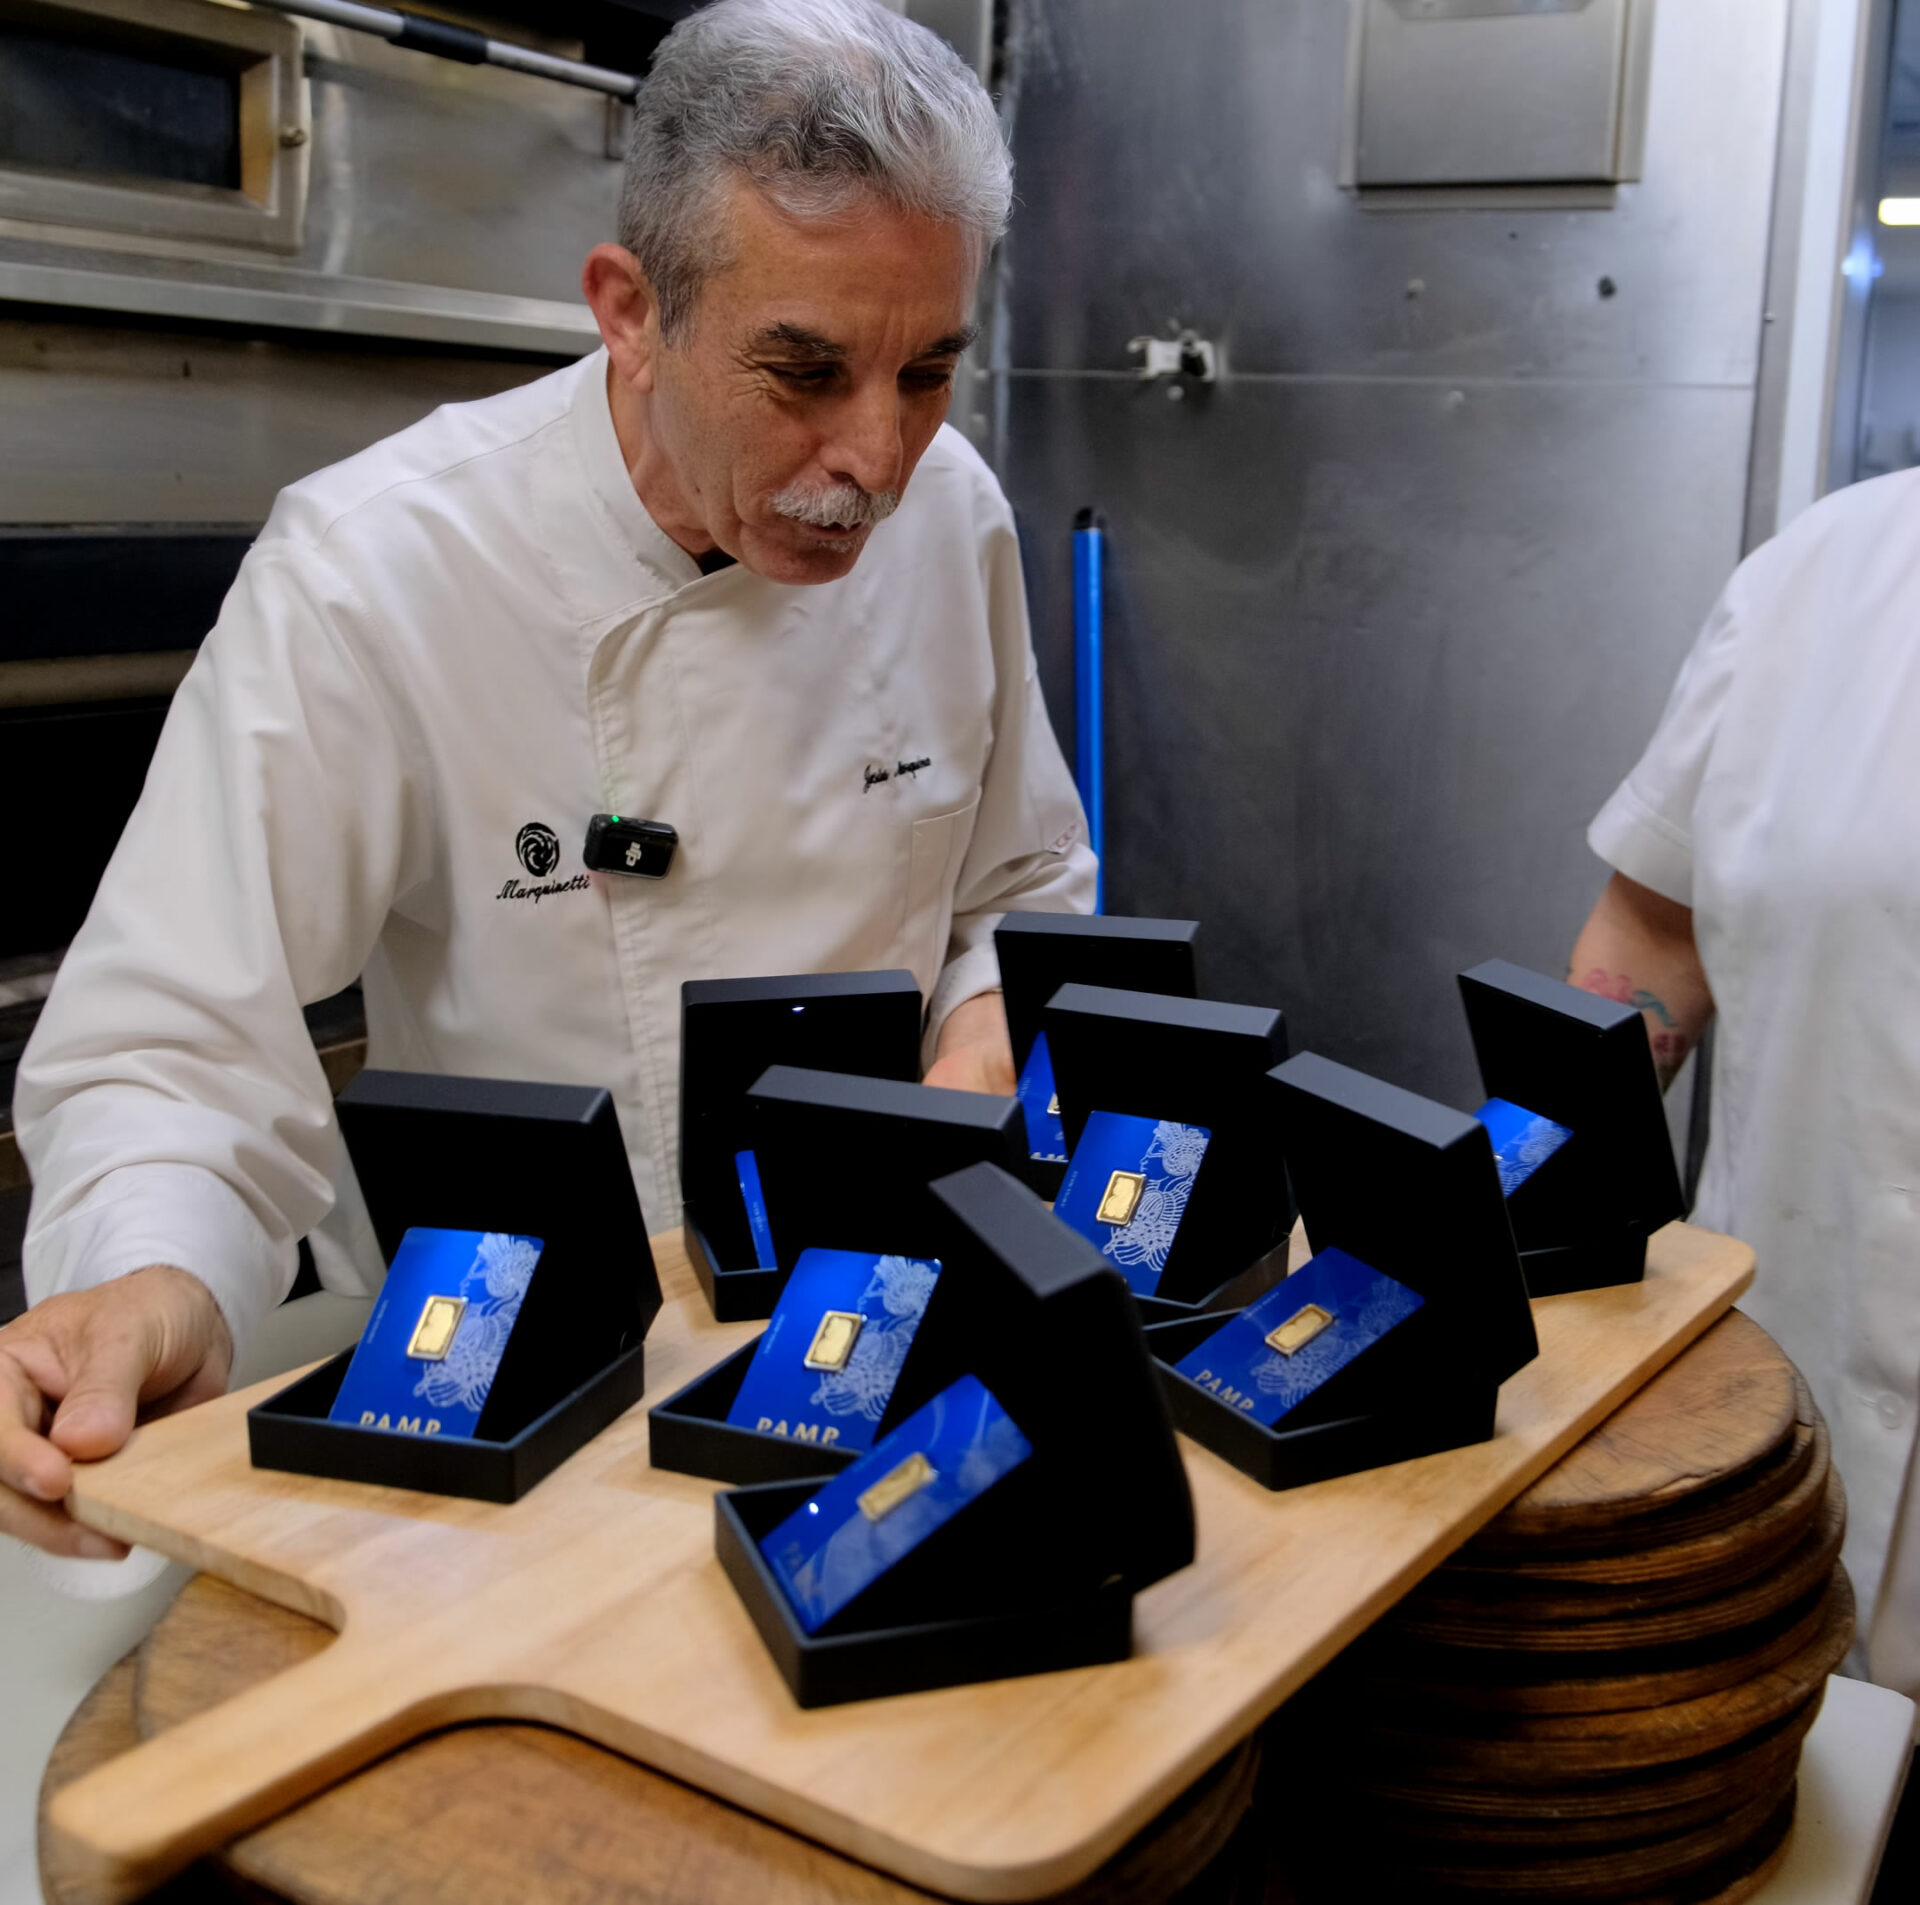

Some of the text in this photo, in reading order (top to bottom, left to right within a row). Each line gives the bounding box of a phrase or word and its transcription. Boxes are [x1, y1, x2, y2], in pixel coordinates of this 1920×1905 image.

[496, 875, 590, 904] Marquinetti
[1195, 1369, 1255, 1410] PAMP
[360, 1410, 441, 1435] PAMP
[756, 1416, 840, 1444] PAMP
